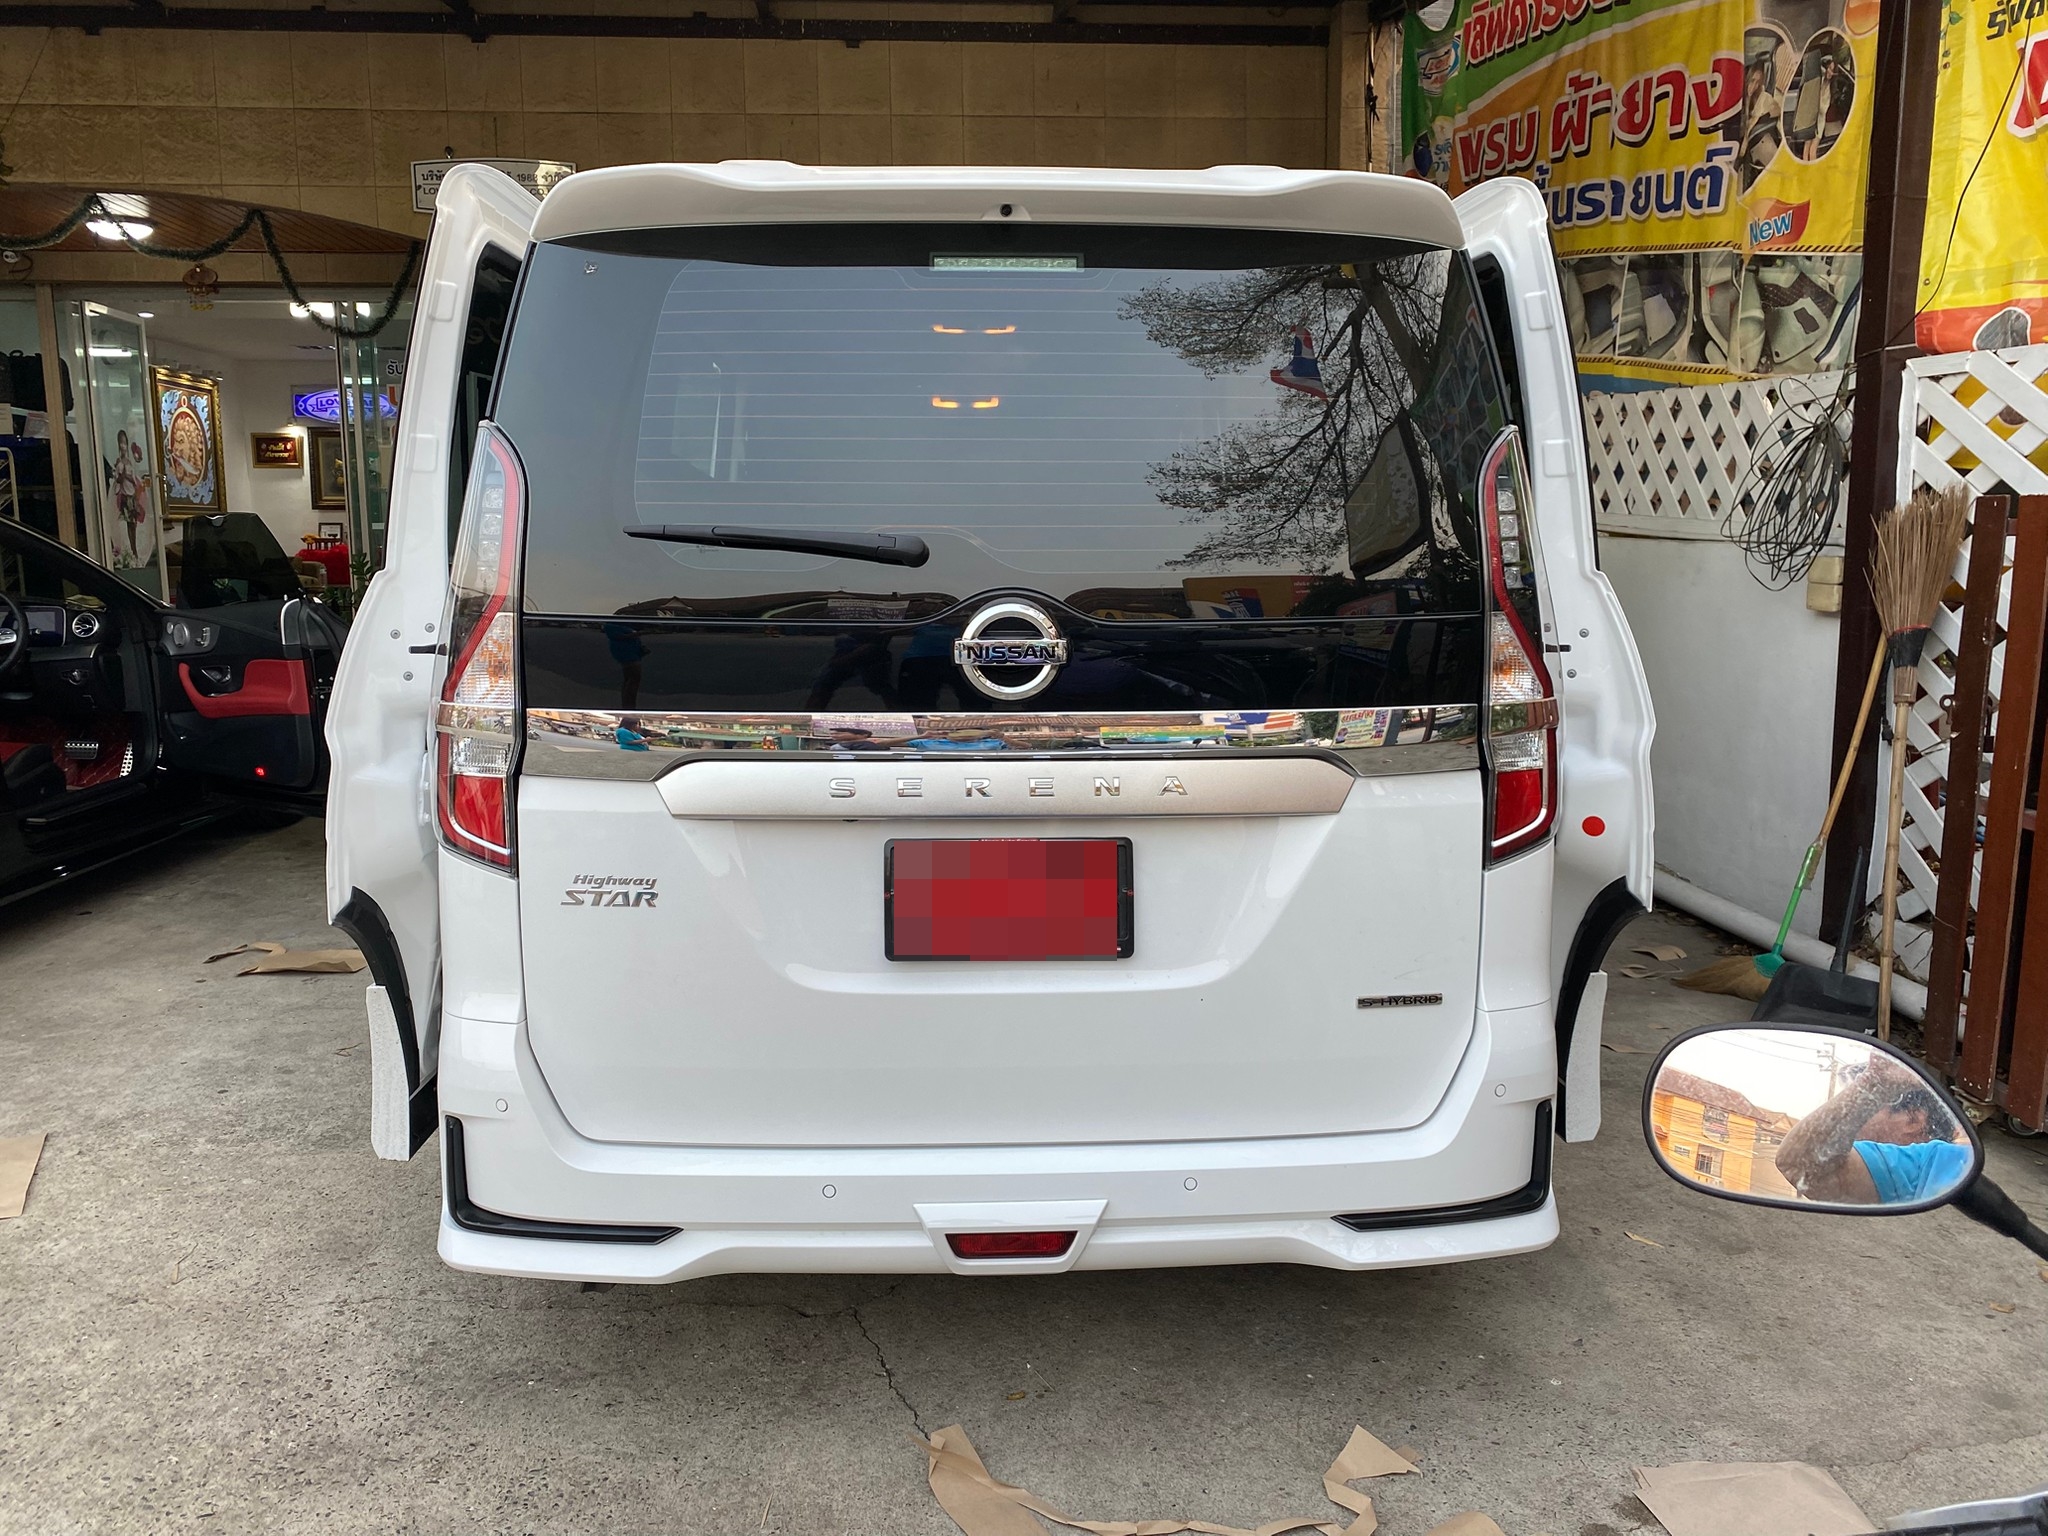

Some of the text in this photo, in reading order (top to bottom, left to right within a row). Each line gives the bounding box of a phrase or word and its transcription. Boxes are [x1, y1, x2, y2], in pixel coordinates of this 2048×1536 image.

[1458, 110, 1538, 178] พรม
[1748, 210, 1793, 248] New
[966, 645, 1057, 660] NISSAN
[828, 775, 1188, 799] SERENA
[572, 873, 658, 890] Highway
[560, 888, 659, 908] STAR
[1361, 995, 1439, 1007] S-HYBRID
